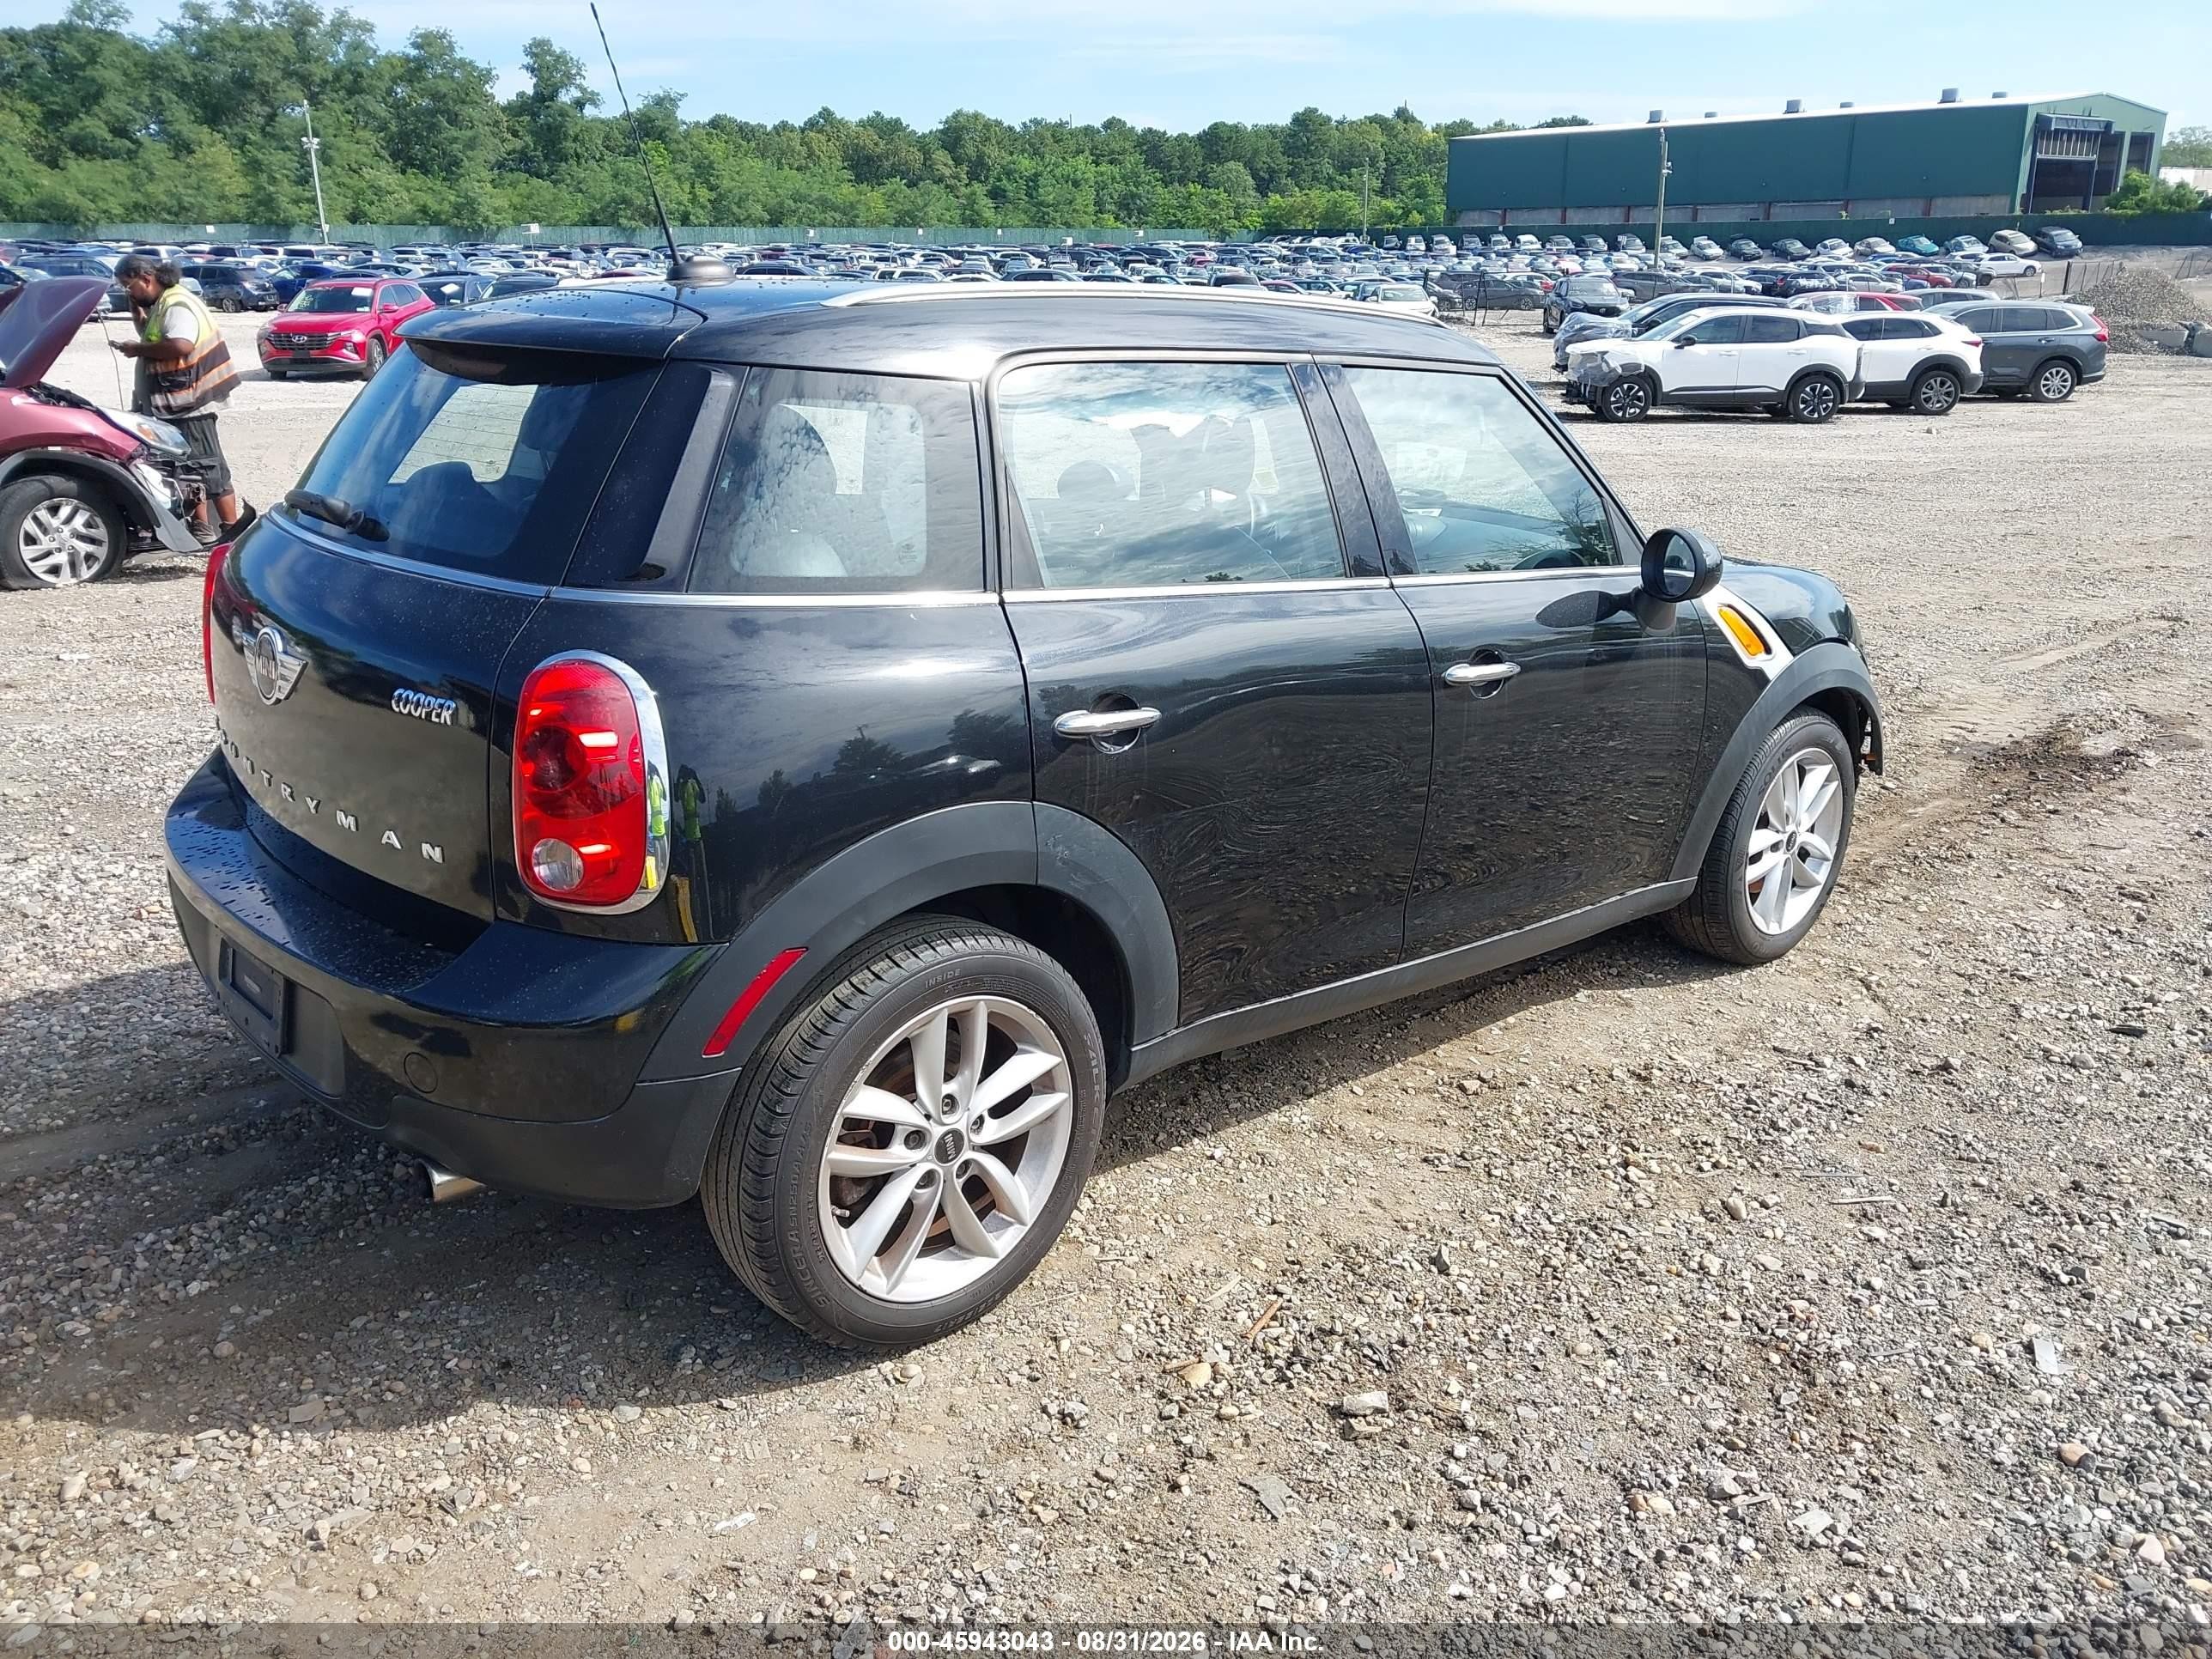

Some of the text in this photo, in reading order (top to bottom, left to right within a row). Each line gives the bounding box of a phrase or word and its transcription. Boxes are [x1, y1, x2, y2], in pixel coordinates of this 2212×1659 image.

[255, 654, 275, 680] MINI
[390, 688, 457, 726] COOPER
[216, 715, 445, 864] OUNTRYMAN
[924, 968, 963, 989] INSIDE
[1084, 1033, 1102, 1148] FALKEN
[944, 1133, 957, 1160] MINI
[787, 1230, 831, 1308] SINCERA
